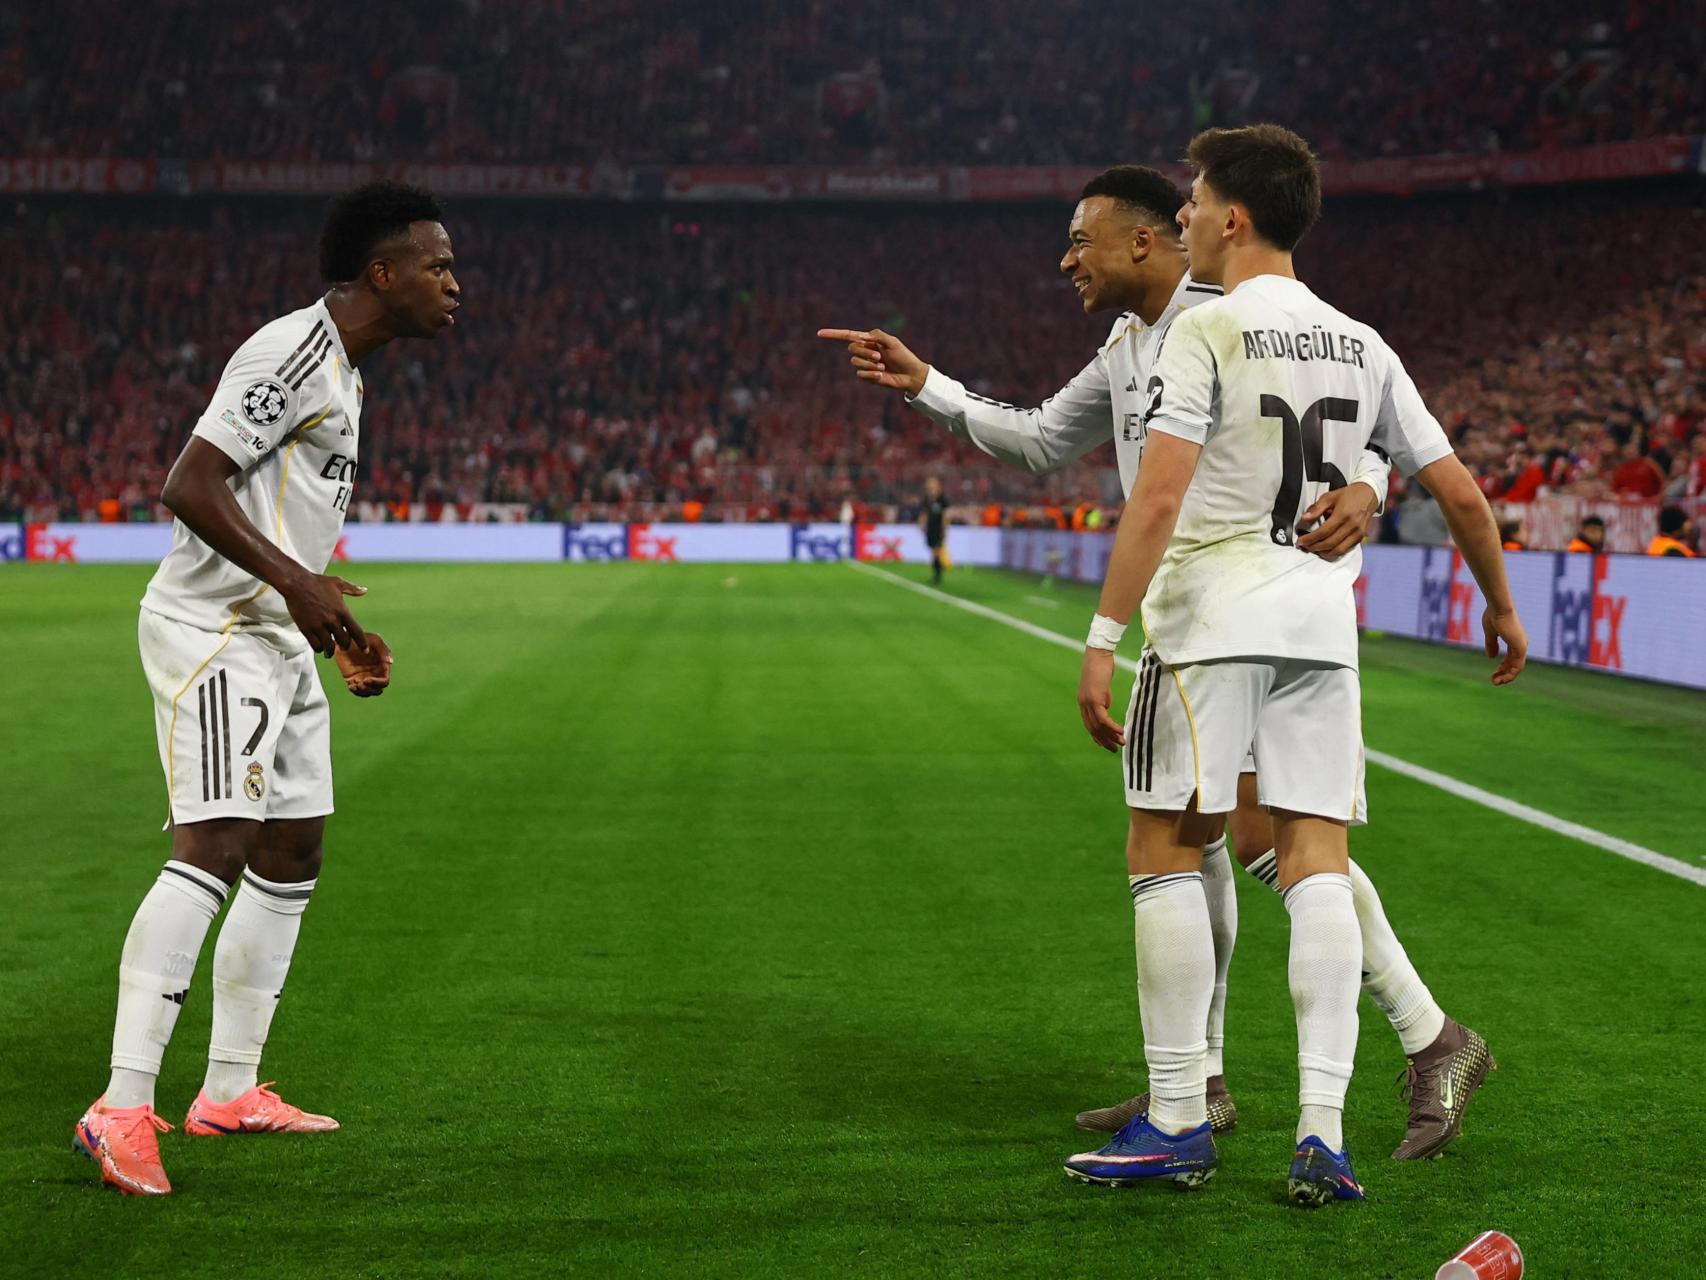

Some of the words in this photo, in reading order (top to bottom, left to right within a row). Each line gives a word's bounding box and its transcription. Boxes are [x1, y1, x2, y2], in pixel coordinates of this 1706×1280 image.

[1260, 393, 1359, 547] 15
[0, 522, 77, 562] dEx
[563, 522, 677, 562] FedEx
[791, 521, 904, 561] FedEx
[240, 697, 269, 756] 7
